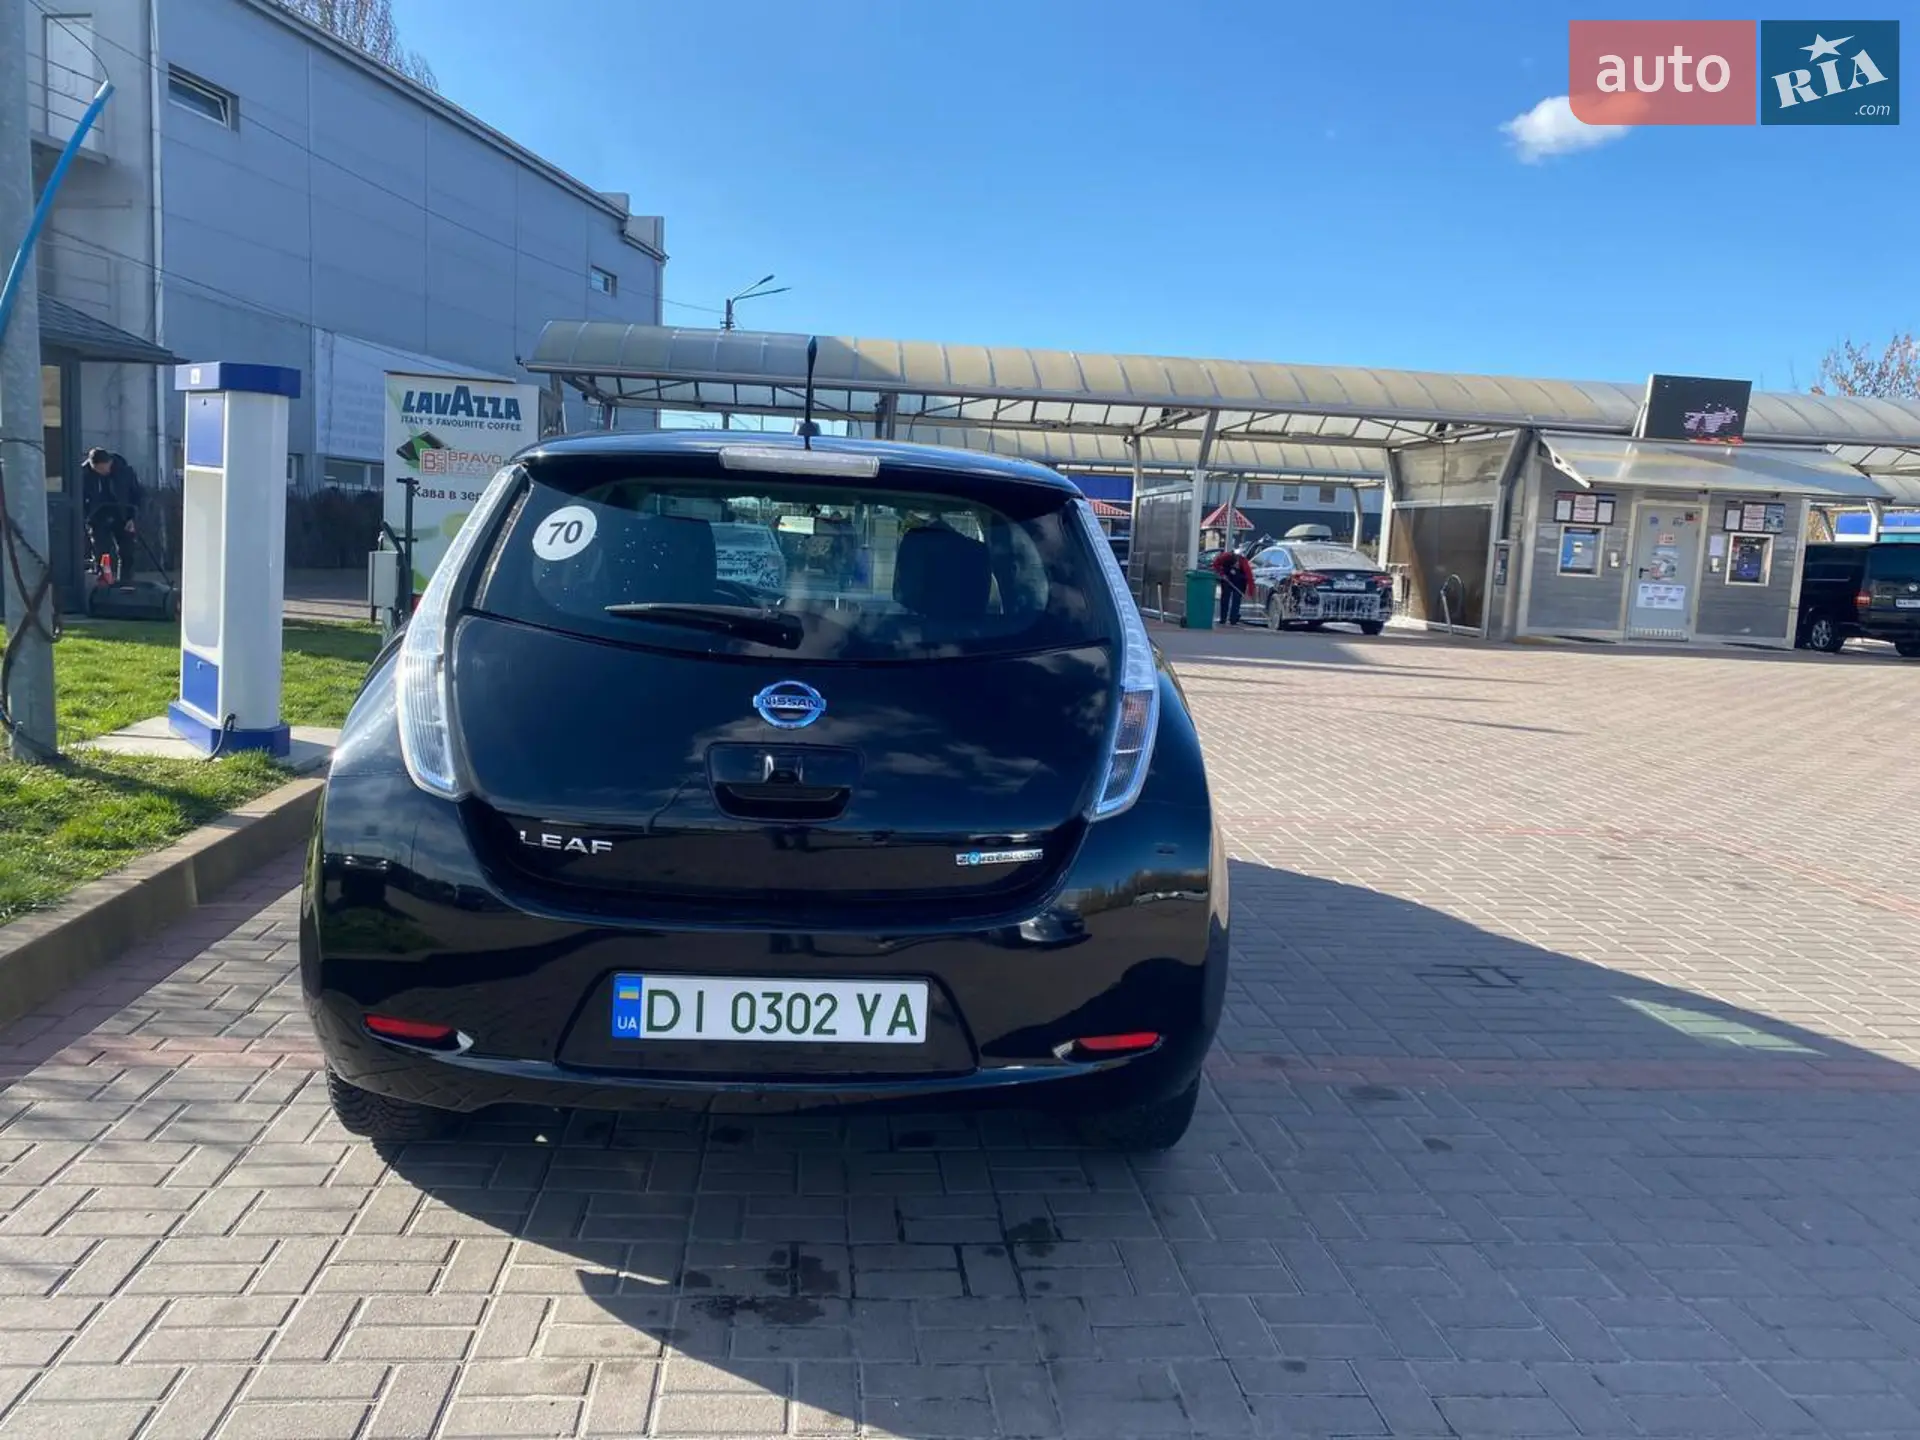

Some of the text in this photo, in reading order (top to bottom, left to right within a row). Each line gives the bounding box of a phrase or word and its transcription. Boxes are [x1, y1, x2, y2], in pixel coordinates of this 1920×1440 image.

[402, 385, 522, 421] LAVAZZA
[401, 415, 521, 432] ITALY'S FAVOURITE COFFEE
[448, 451, 503, 465] BRAVO
[411, 485, 445, 500] Кава
[448, 490, 457, 500] в
[548, 520, 583, 546] 70
[761, 696, 819, 709] NISSAN
[520, 830, 613, 854] LEAF
[646, 989, 918, 1037] DI 0302 YA
[617, 1016, 637, 1030] UA
